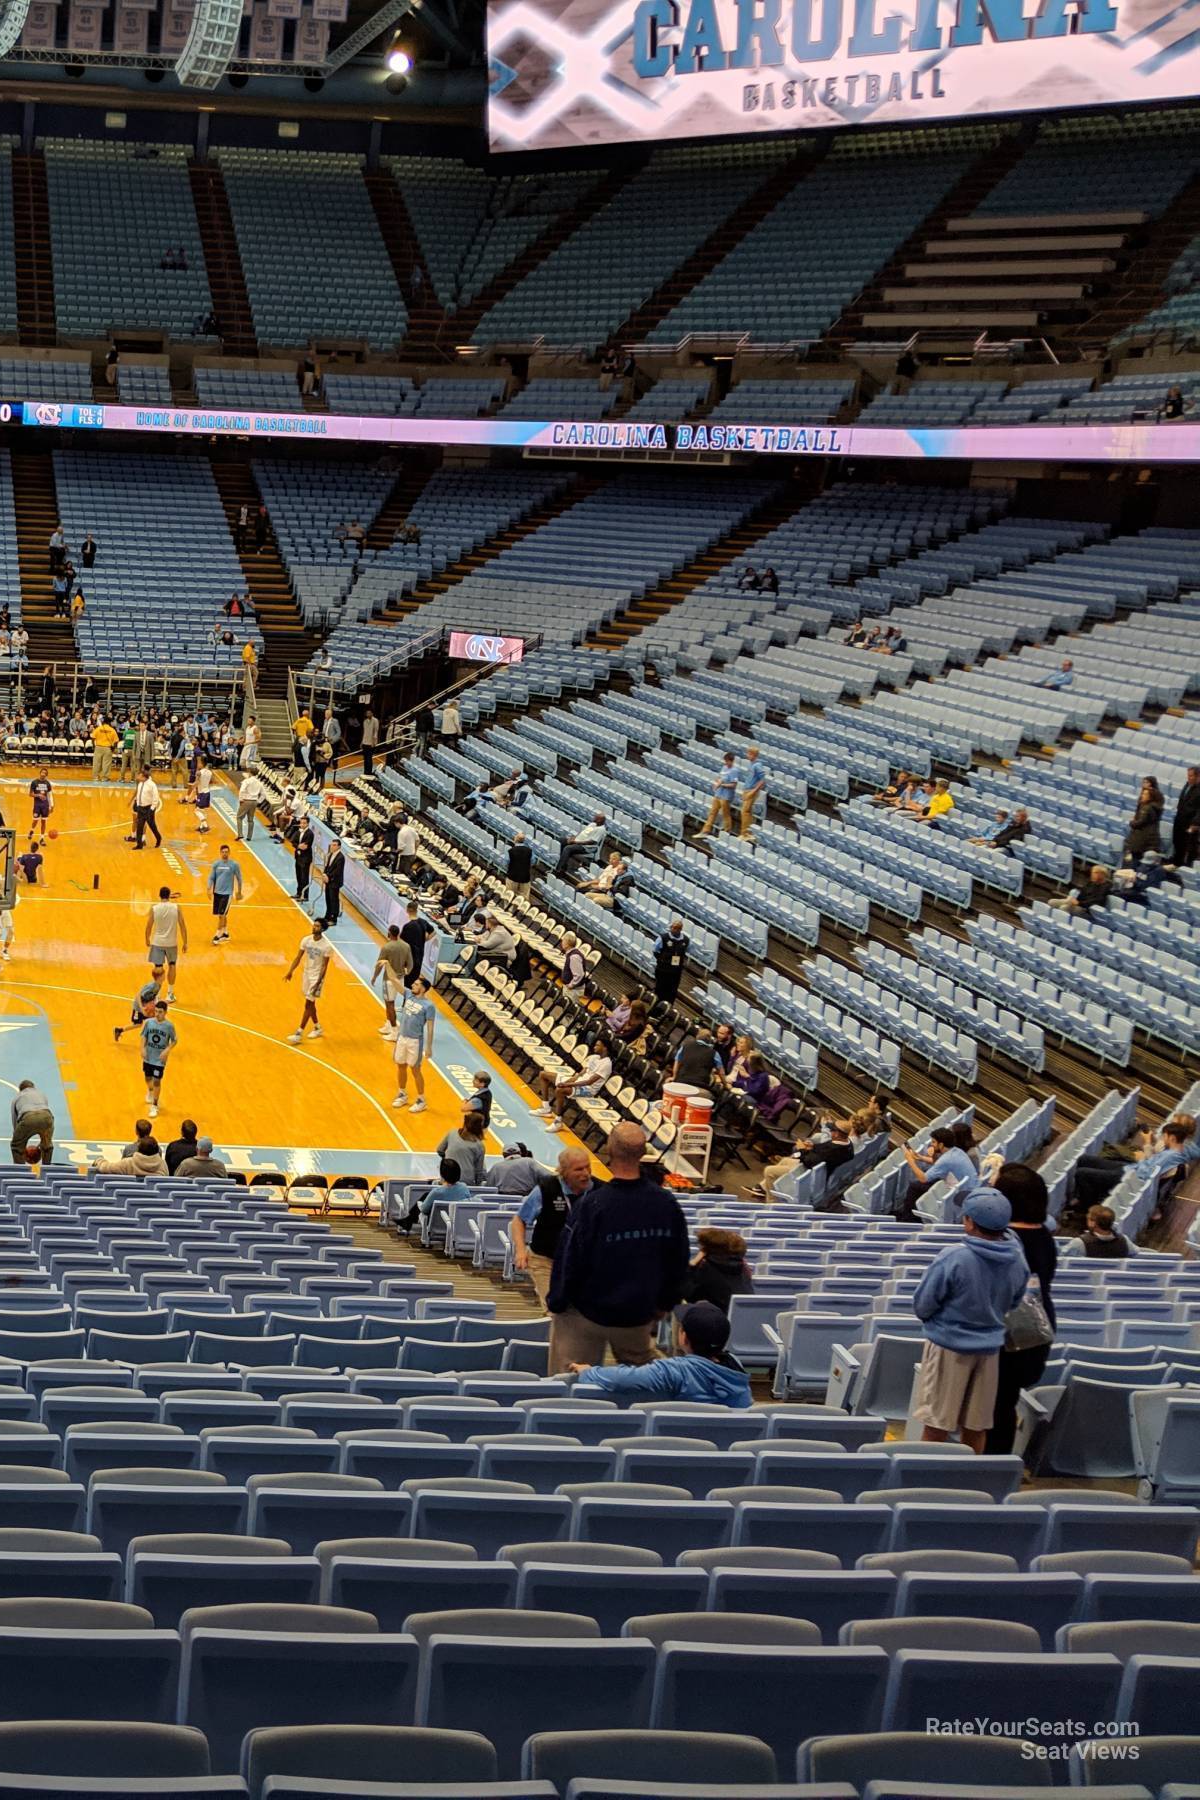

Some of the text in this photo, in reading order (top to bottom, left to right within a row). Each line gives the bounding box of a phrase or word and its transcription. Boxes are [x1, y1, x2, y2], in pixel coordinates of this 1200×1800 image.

[743, 67, 947, 112] BASKETBALL
[0, 404, 12, 422] 0
[135, 411, 328, 434] HOME OF CAROLINA BASKETBALL
[553, 423, 842, 452] CAROLINA BASKETBALL
